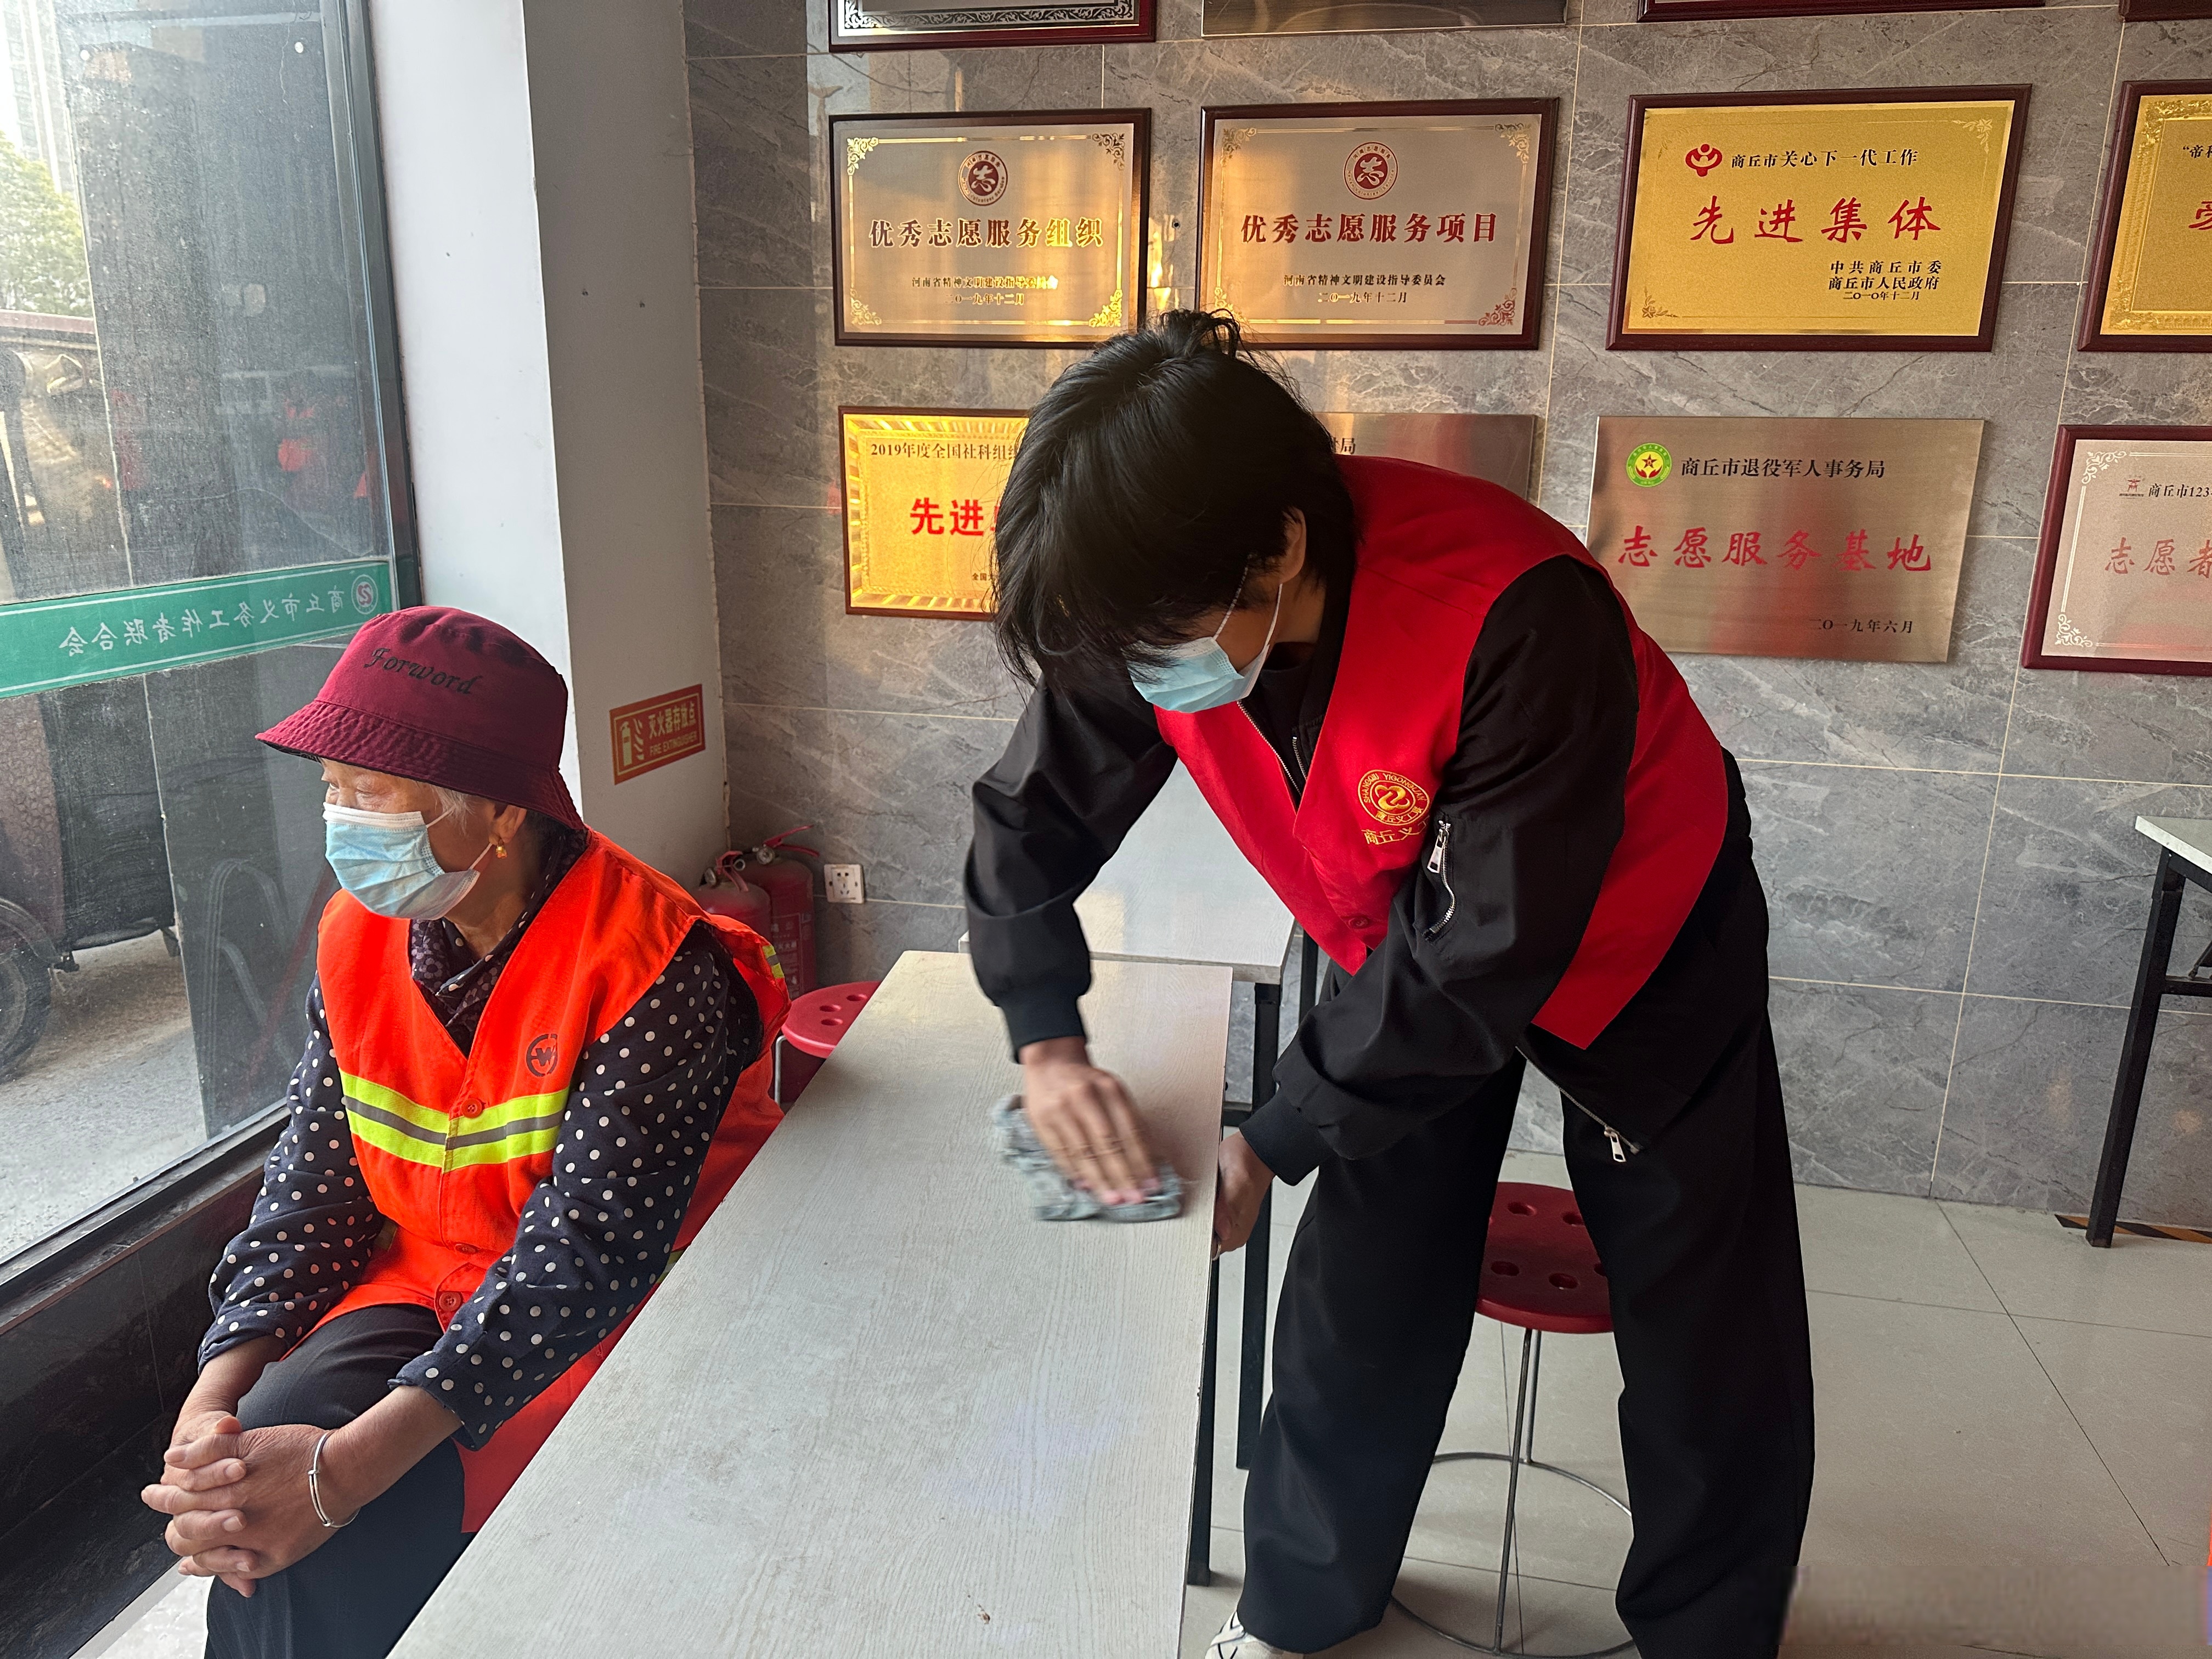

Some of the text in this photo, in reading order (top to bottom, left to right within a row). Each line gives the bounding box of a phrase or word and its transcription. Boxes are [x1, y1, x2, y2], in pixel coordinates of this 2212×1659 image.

[1731, 148, 1918, 168] 商丘市关心下一代工作
[1240, 213, 1497, 244] 优秀志愿服务项目
[1690, 195, 1942, 244] 先进集体
[869, 217, 1104, 248] 优秀志愿服务组织
[1830, 259, 1942, 274] 中共商丘市委
[1284, 274, 1446, 286] 河南省精神文明建设指导委员会
[1828, 276, 1940, 290] 商丘市人民政府
[1680, 456, 1886, 479] 商丘市退役军人事务局
[2148, 483, 2212, 498] 商丘市123
[910, 497, 1000, 537] 先进
[1617, 525, 1932, 572] 志愿服务基地
